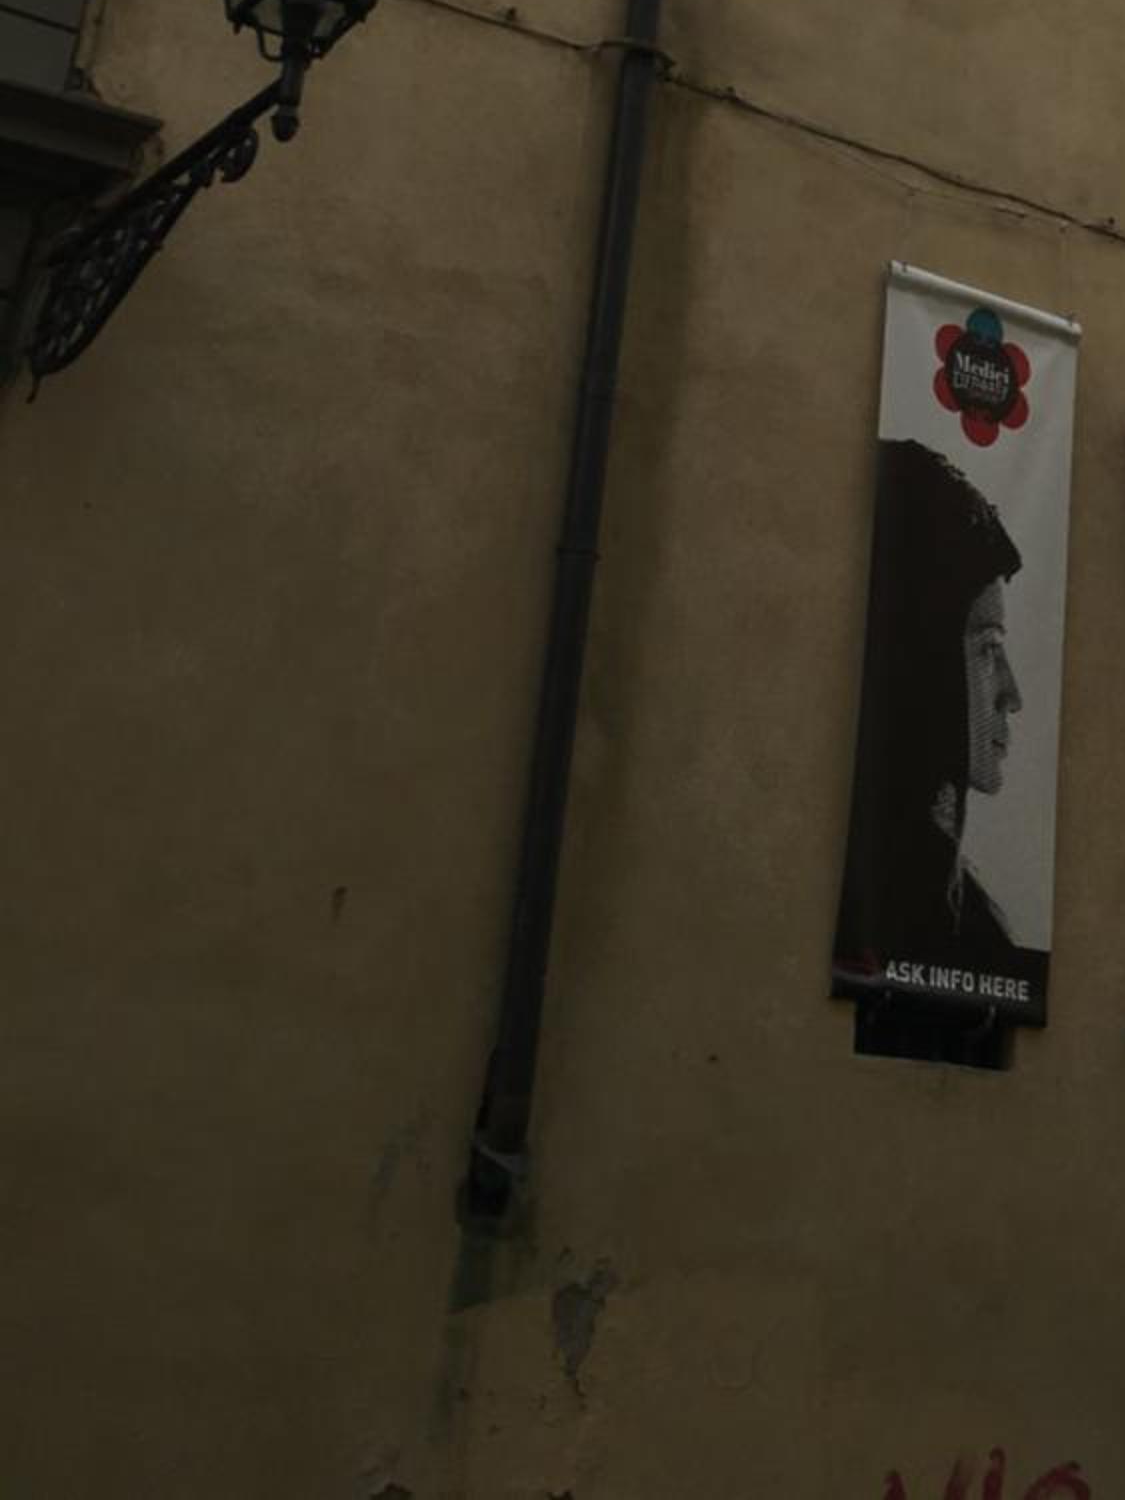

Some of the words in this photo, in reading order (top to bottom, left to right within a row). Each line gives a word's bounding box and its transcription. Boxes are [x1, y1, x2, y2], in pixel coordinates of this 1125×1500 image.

[885, 959, 926, 986] ASK
[929, 965, 974, 993] INFO
[979, 973, 1030, 1002] HERE
